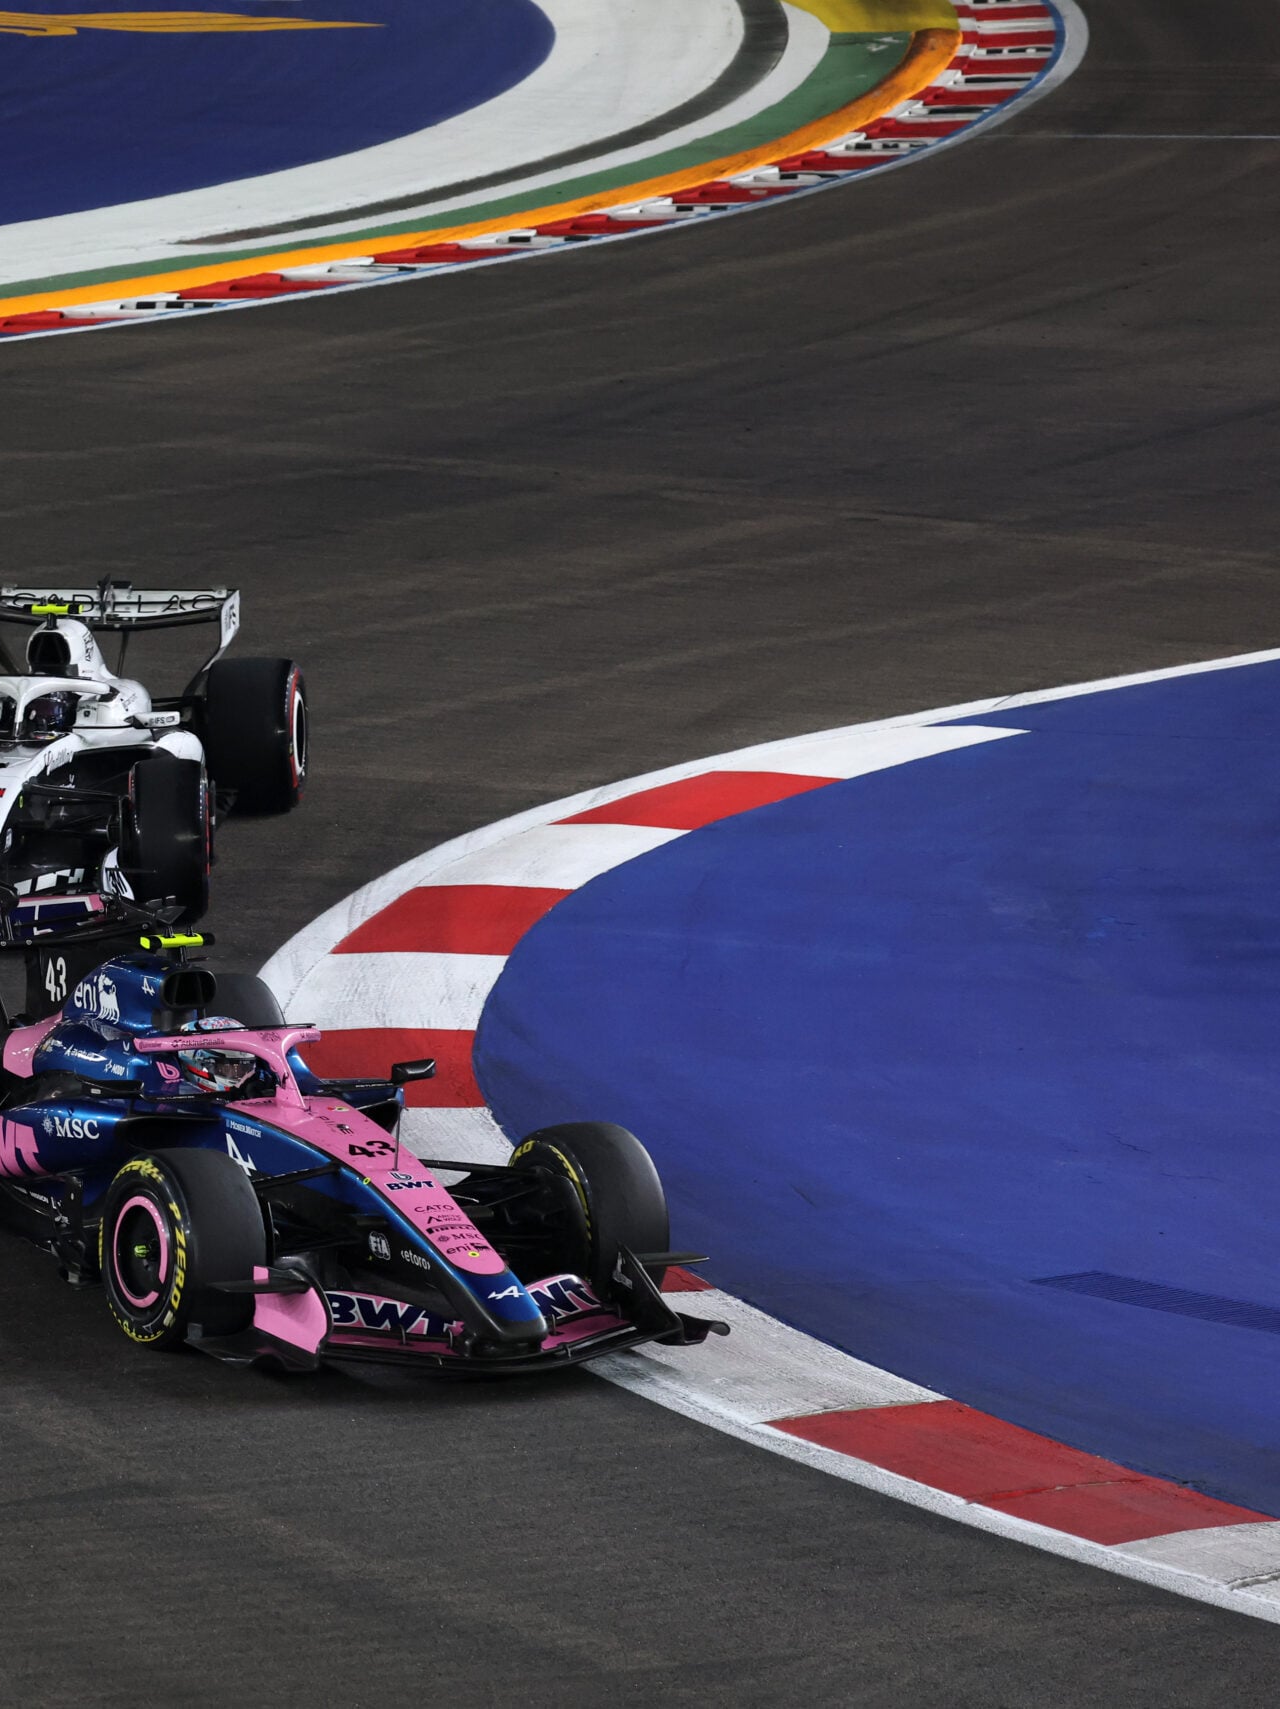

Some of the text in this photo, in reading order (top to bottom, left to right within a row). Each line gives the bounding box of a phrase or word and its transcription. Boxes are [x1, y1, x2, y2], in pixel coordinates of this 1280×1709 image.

[45, 956, 67, 1002] 43
[74, 975, 97, 1013] eni
[54, 1116, 100, 1139] MSC
[348, 1140, 396, 1158] 43
[385, 1180, 435, 1191] BWT
[414, 1204, 454, 1213] CATO
[426, 1223, 477, 1235] PIRELLI
[452, 1232, 484, 1240] MSC
[370, 1235, 388, 1255] FIA
[446, 1243, 471, 1254] eni
[171, 1226, 187, 1310] ZERO
[528, 1277, 601, 1320] WT
[324, 1290, 457, 1336] BWT
